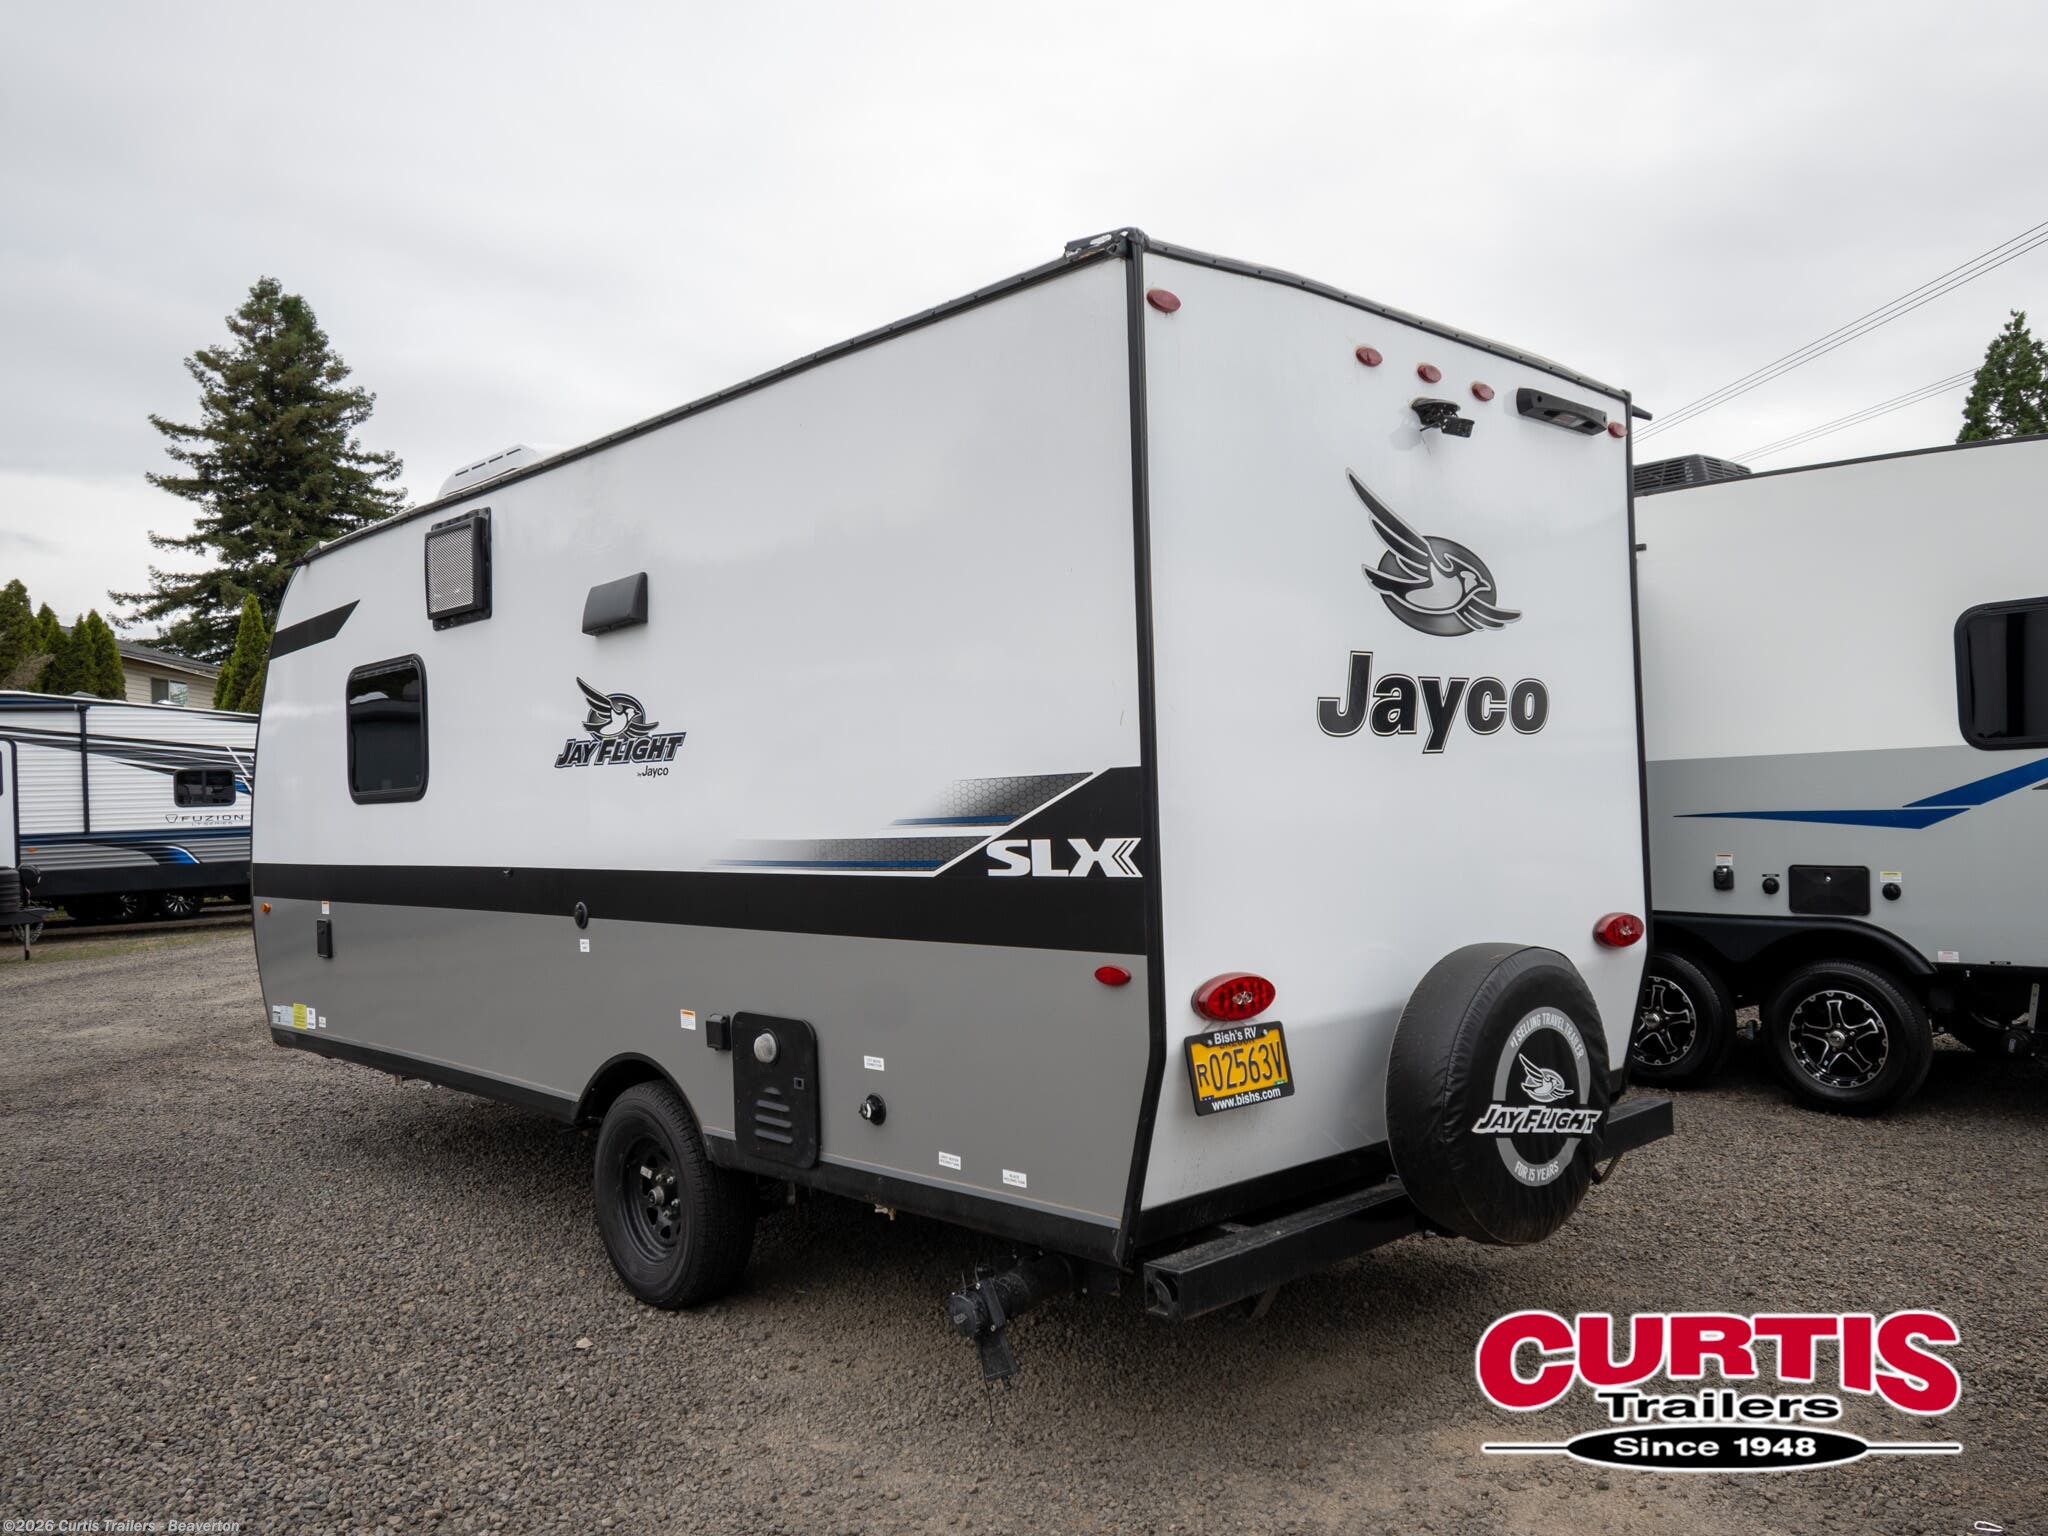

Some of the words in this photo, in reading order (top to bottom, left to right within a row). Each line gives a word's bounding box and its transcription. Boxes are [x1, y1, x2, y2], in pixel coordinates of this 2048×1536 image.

[1317, 650, 1550, 754] Jayco
[555, 738, 600, 768] JAY
[594, 732, 687, 766] FLIGHT
[642, 765, 669, 778] Jayco
[181, 814, 245, 822] FUZION
[986, 838, 1143, 878] SLX
[1213, 1029, 1244, 1046] Bish's
[1244, 1026, 1258, 1041] RV
[1509, 1036, 1519, 1049] #1
[1516, 1014, 1542, 1042] SELLING
[1542, 1012, 1566, 1031] TRAVEL
[1565, 1022, 1585, 1060] TRAILER
[1196, 1041, 1283, 1092] R02563V
[1211, 1087, 1282, 1112] www.bishs.com
[1471, 1103, 1524, 1135] JAY
[1517, 1104, 1603, 1135] FLIGHT
[1514, 1160, 1529, 1180] FOR
[1528, 1167, 1536, 1182] 15
[1536, 1160, 1560, 1182] YEARS
